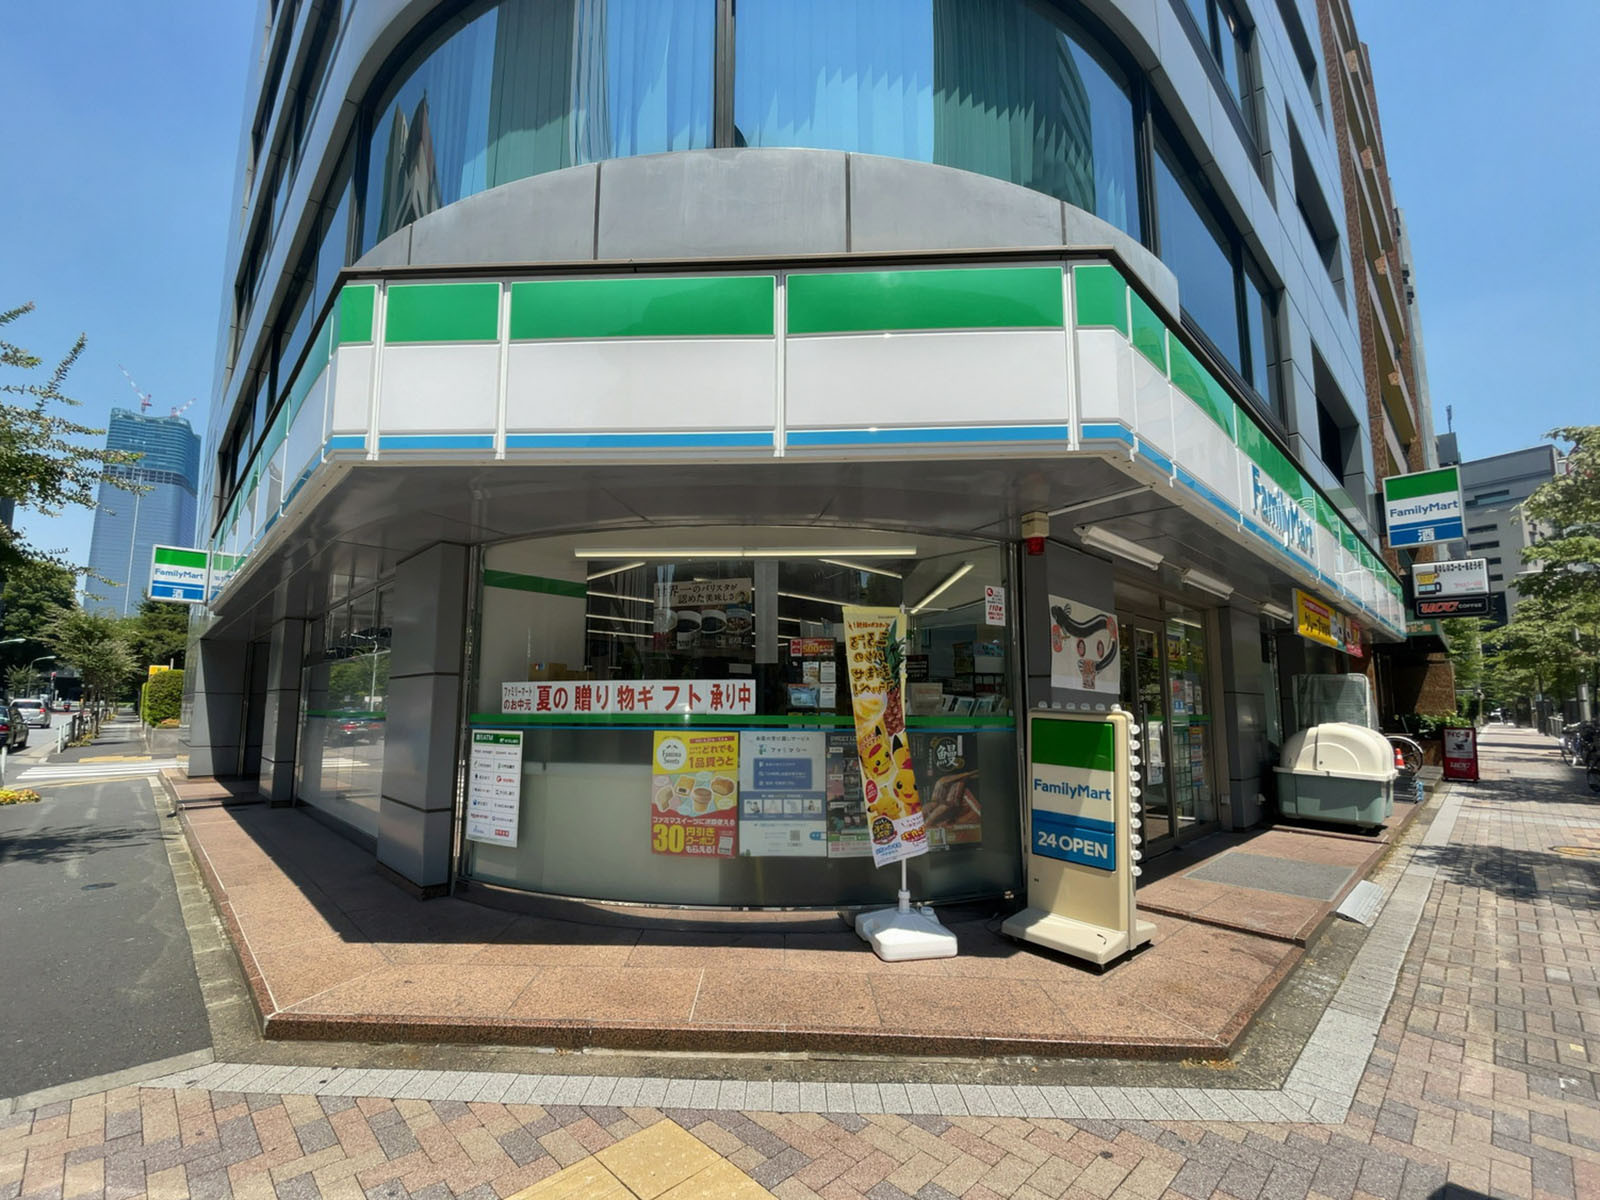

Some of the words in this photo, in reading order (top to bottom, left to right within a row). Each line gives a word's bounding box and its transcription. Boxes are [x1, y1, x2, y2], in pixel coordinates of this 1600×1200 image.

[1252, 462, 1315, 559] FamilyMart
[1389, 500, 1459, 518] FamilyMart
[1416, 528, 1435, 542] 酒
[154, 568, 204, 580] FamilyMart
[172, 588, 184, 599] 酒
[678, 592, 736, 605] 認めた美味しさ
[1420, 601, 1459, 613] UCC
[503, 687, 532, 698] ファミリーマート
[536, 683, 752, 712] 夏の贈り物ギフト承り中
[503, 699, 532, 711] のお中元
[689, 755, 734, 769] 1品買うと
[936, 744, 959, 767] 鰻
[1034, 778, 1111, 802] FamilyMart
[653, 823, 685, 853] 30
[686, 826, 716, 837] 円引き
[686, 836, 716, 846] クーポン
[1037, 831, 1057, 849] 24
[1059, 835, 1109, 859] OPEN
